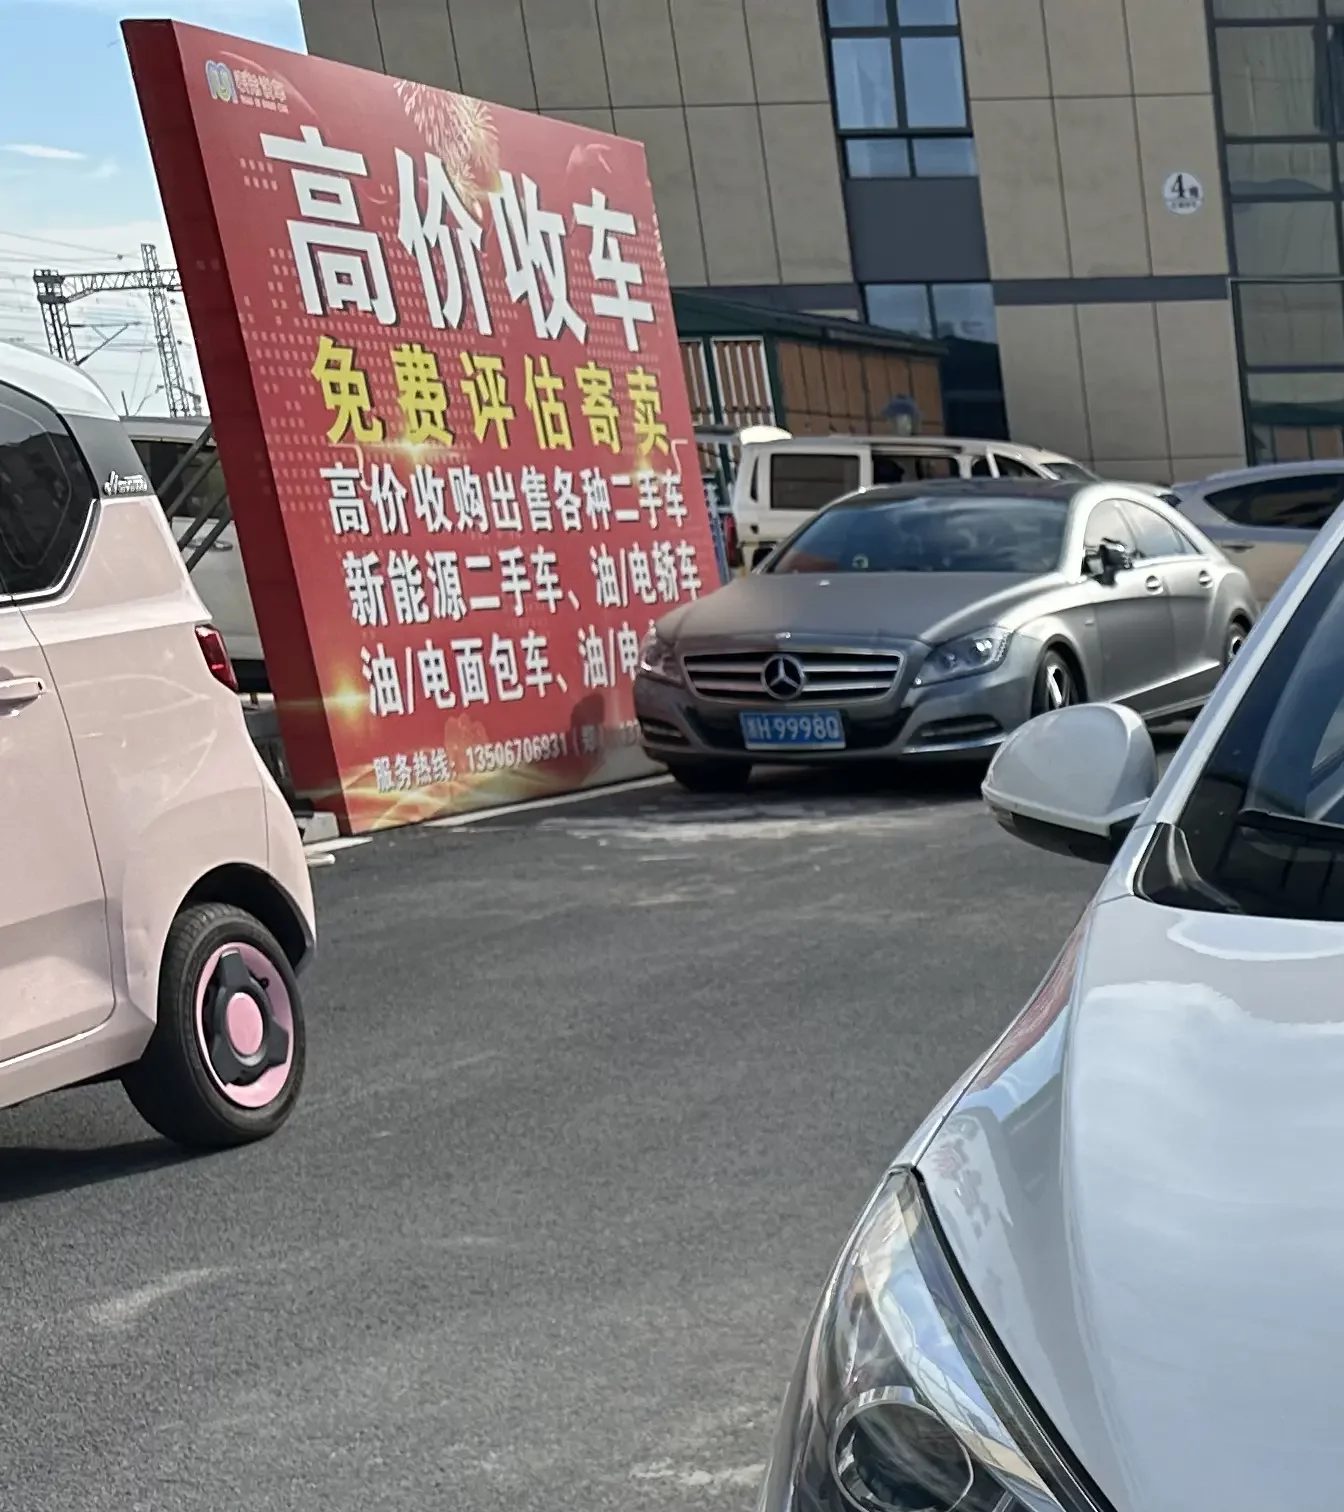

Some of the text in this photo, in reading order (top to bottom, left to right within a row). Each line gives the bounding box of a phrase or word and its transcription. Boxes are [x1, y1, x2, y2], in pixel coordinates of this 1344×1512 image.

[259, 124, 655, 352] 高价收车
[311, 335, 671, 456] 免费评估寄卖
[319, 461, 688, 535] 高价收购出售各种二手车
[342, 539, 702, 627] 新能源二手车、油/电轿车
[361, 619, 656, 717] 油/电面包车、油/电
